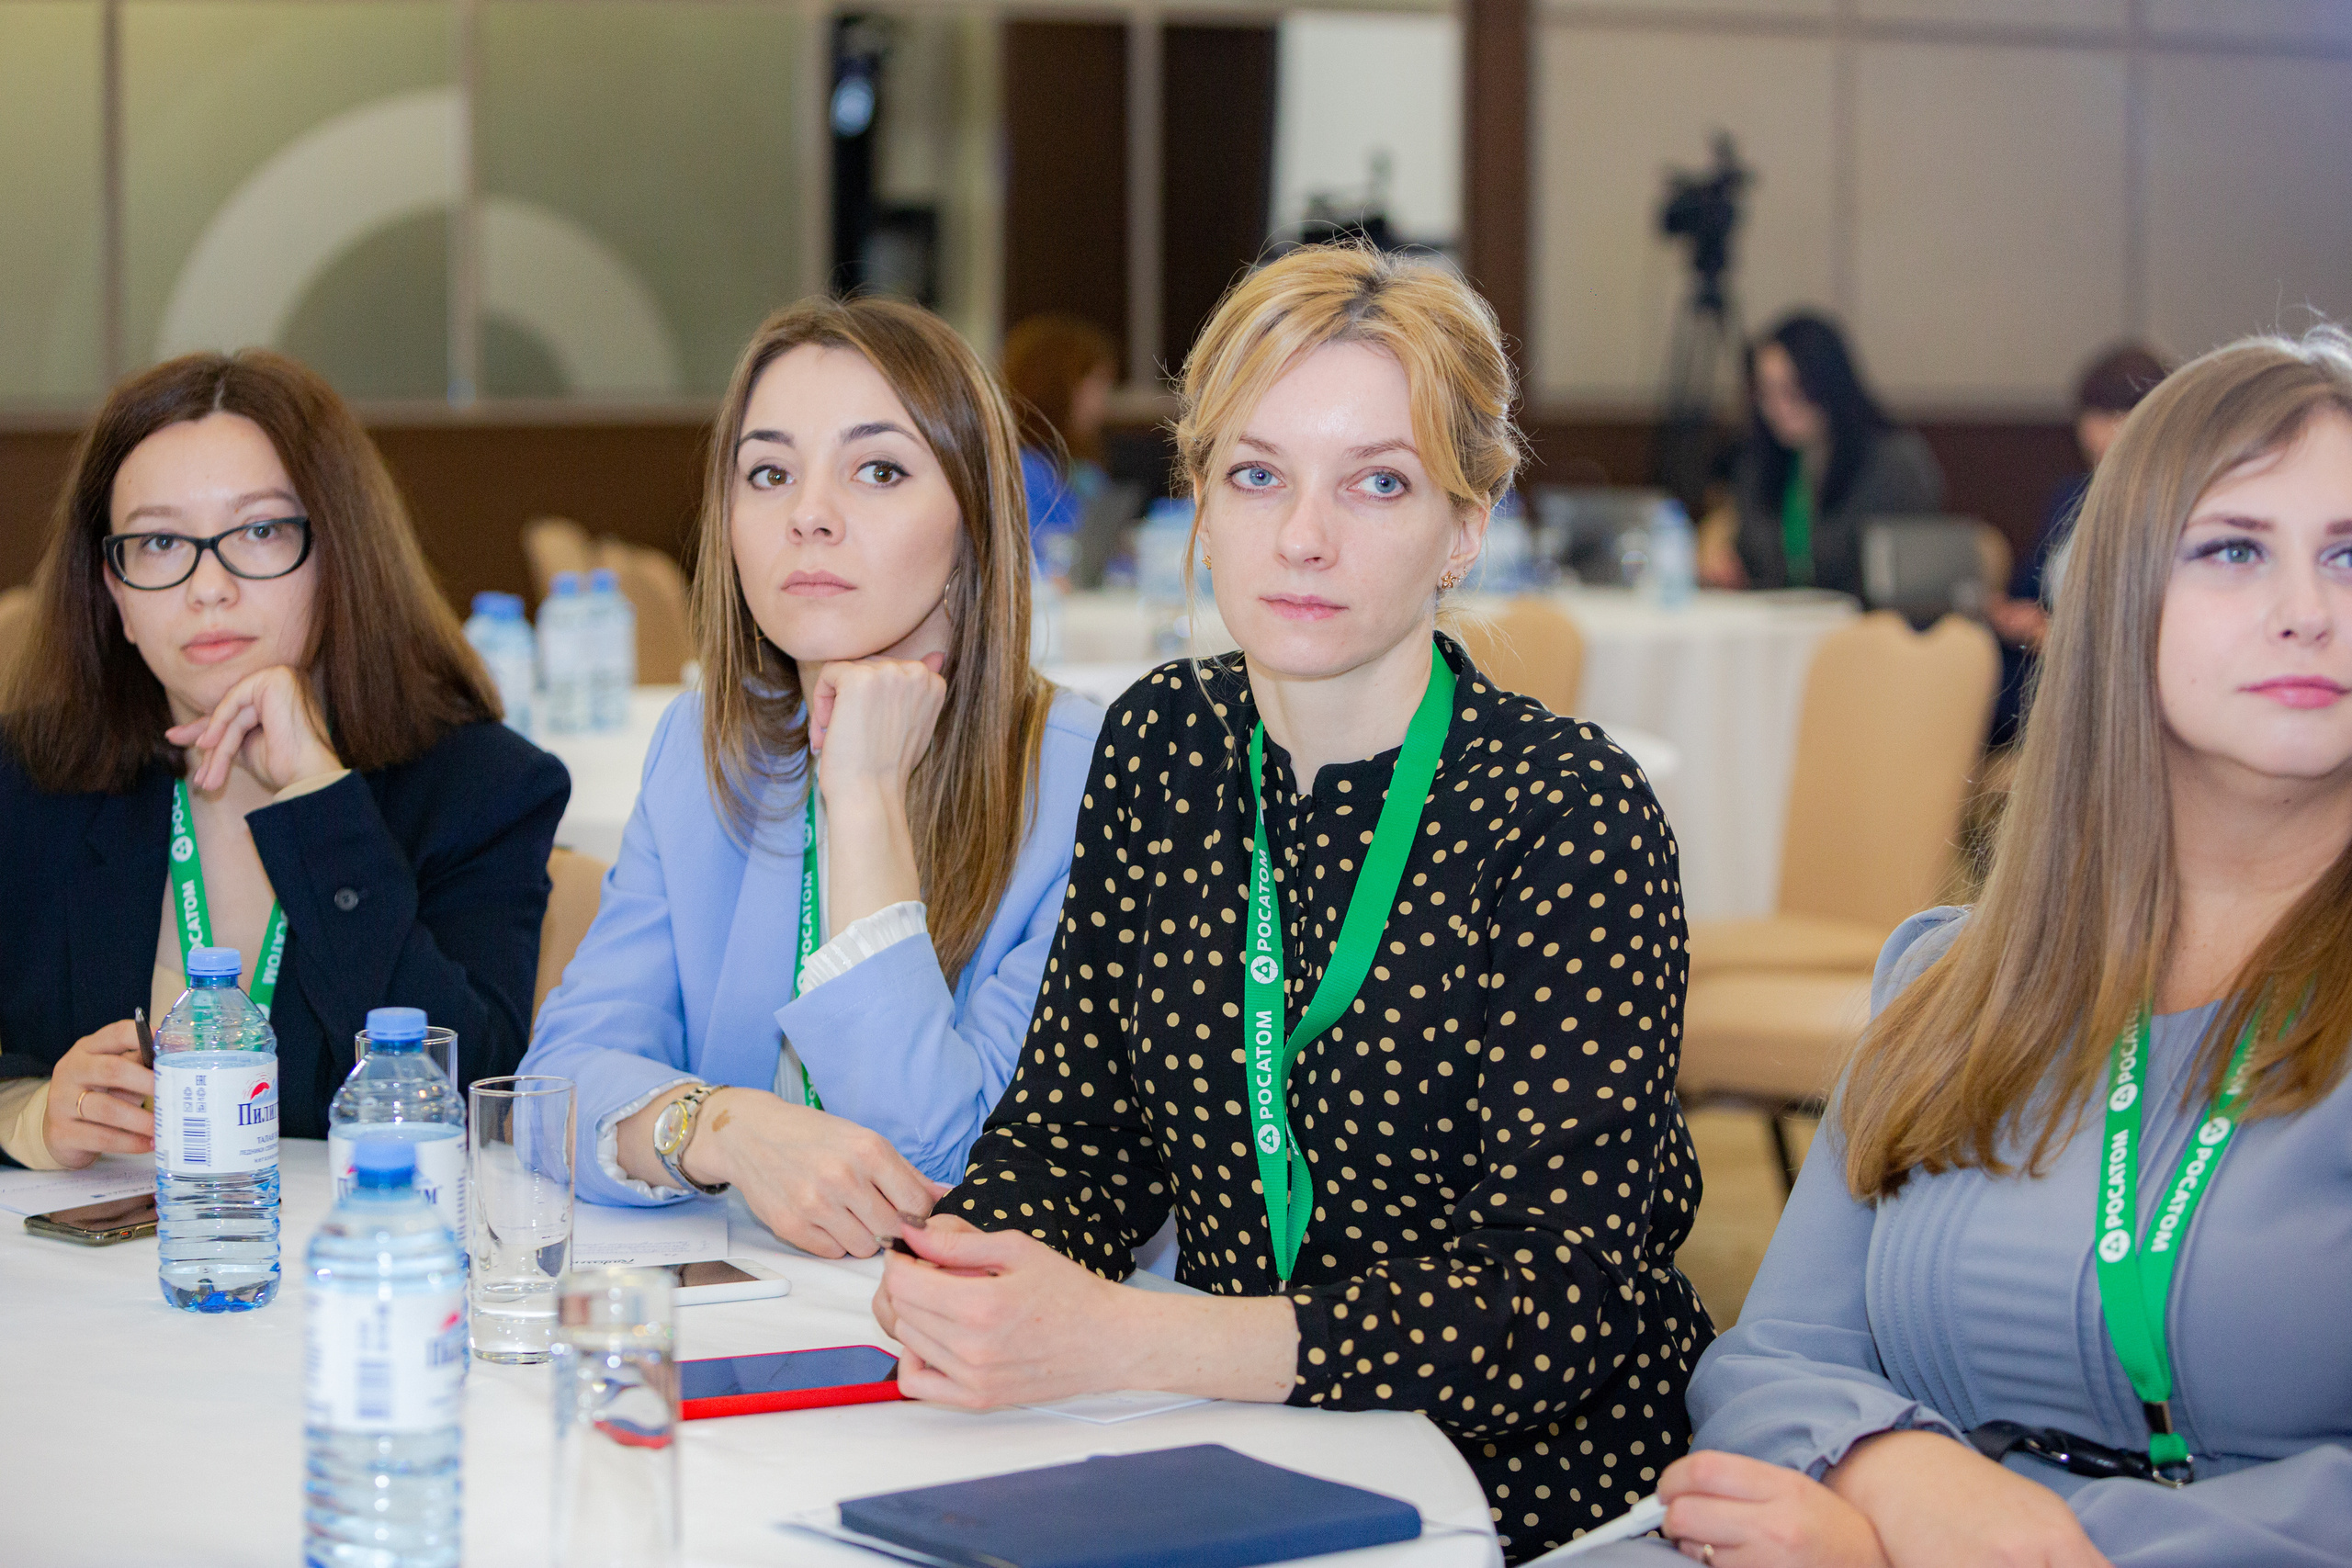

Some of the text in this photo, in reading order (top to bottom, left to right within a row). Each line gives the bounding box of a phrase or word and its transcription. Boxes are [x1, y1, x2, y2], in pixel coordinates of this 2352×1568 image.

[1256, 848, 1271, 953] РОСАТОМ
[1256, 1009, 1272, 1120] РОСАТОМ
[2104, 1128, 2130, 1230] РОСАТОМ
[2150, 1145, 2213, 1253] РОСАТОМ
